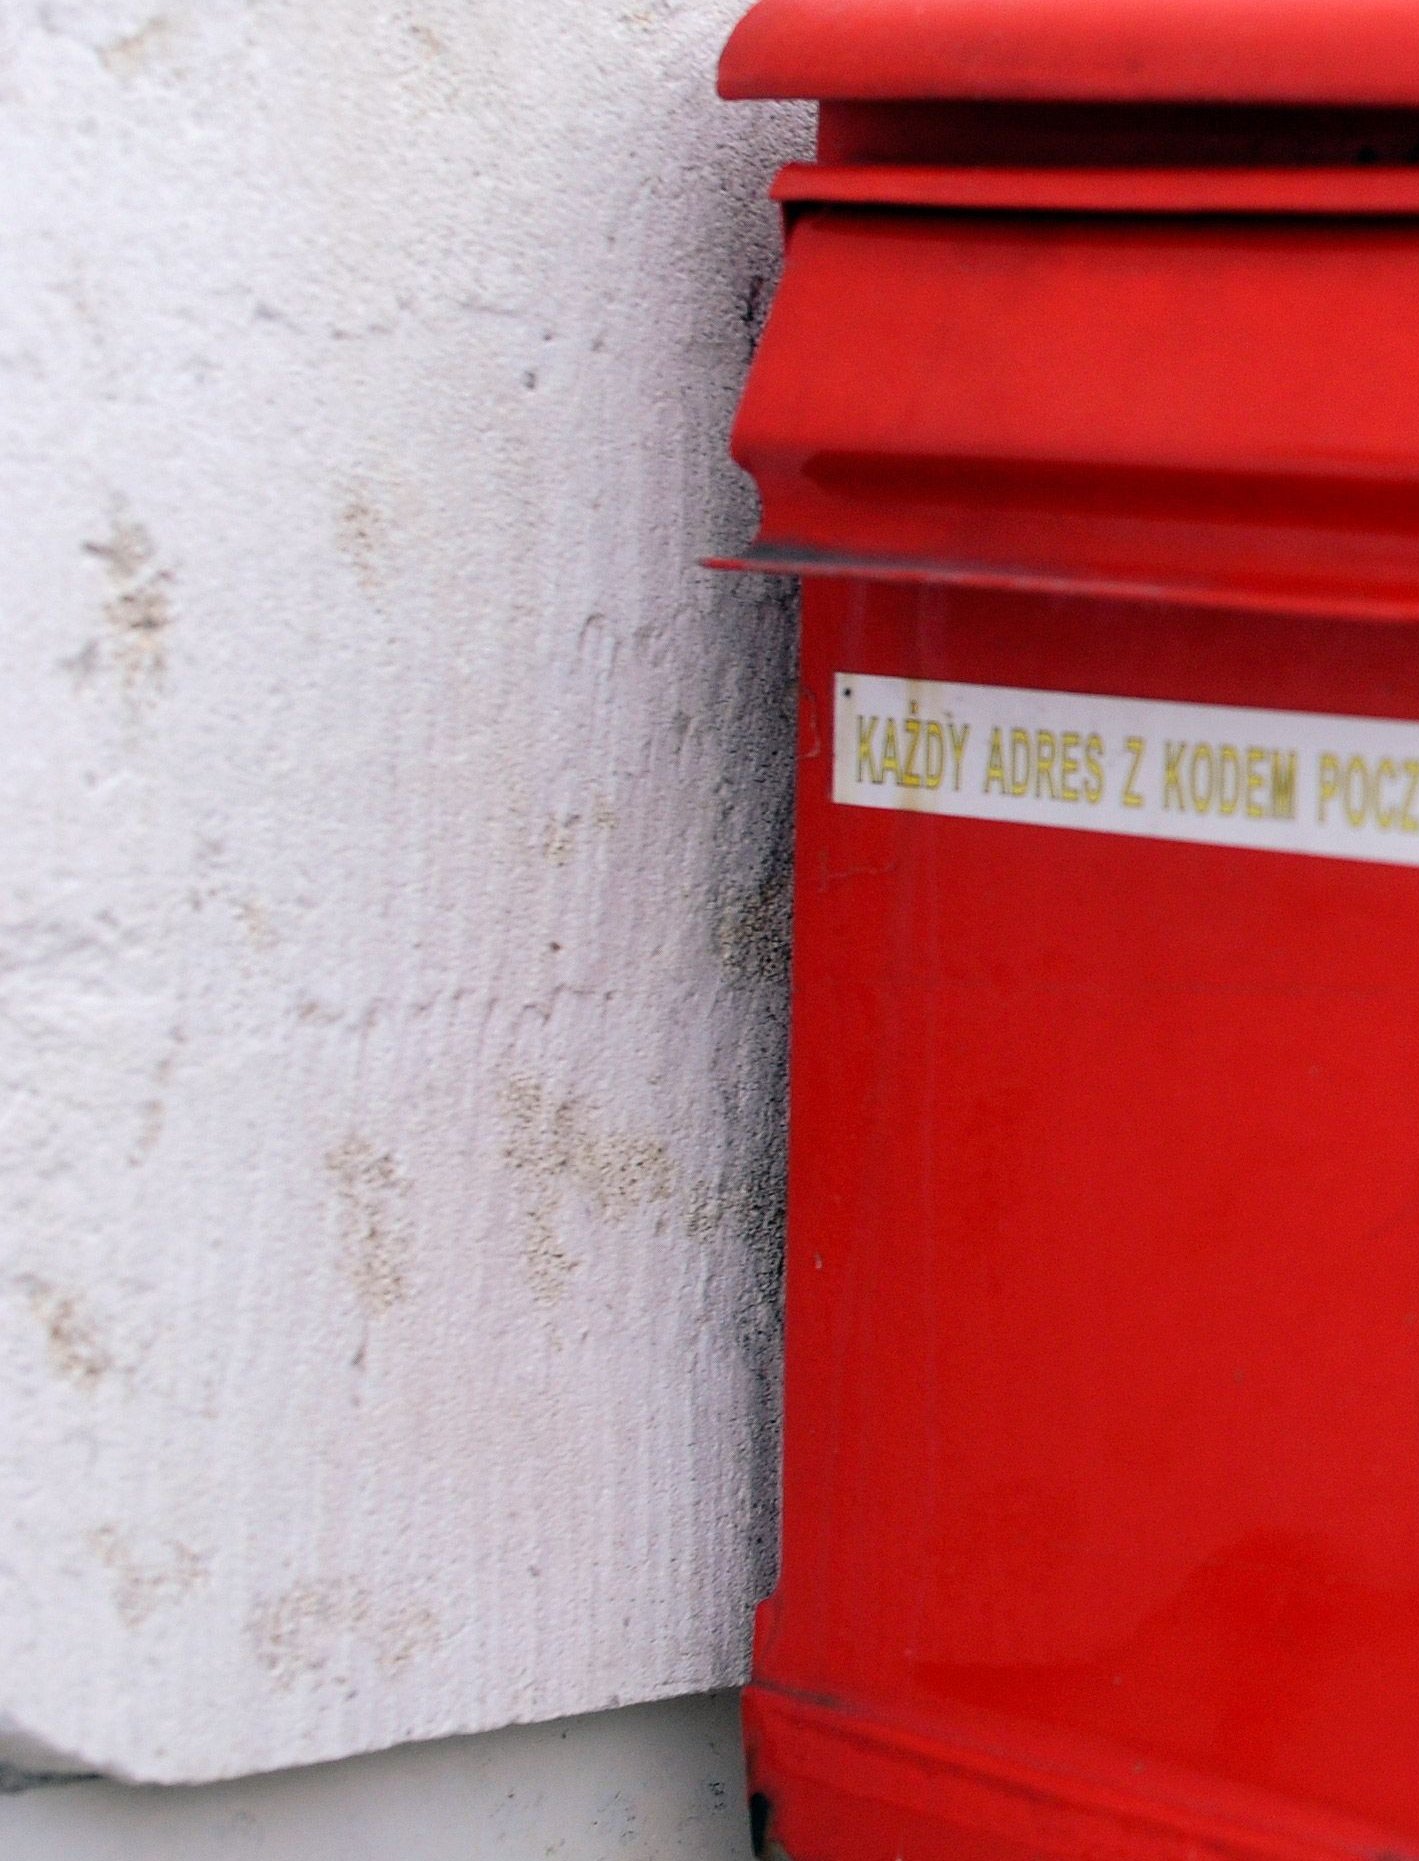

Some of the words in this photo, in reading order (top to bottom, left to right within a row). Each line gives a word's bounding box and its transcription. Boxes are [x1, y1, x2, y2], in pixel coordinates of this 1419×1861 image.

[856, 701, 970, 791] KAŻDY
[984, 725, 1103, 803] ADRES
[1121, 737, 1144, 806] Z
[1164, 742, 1297, 821] KODEM
